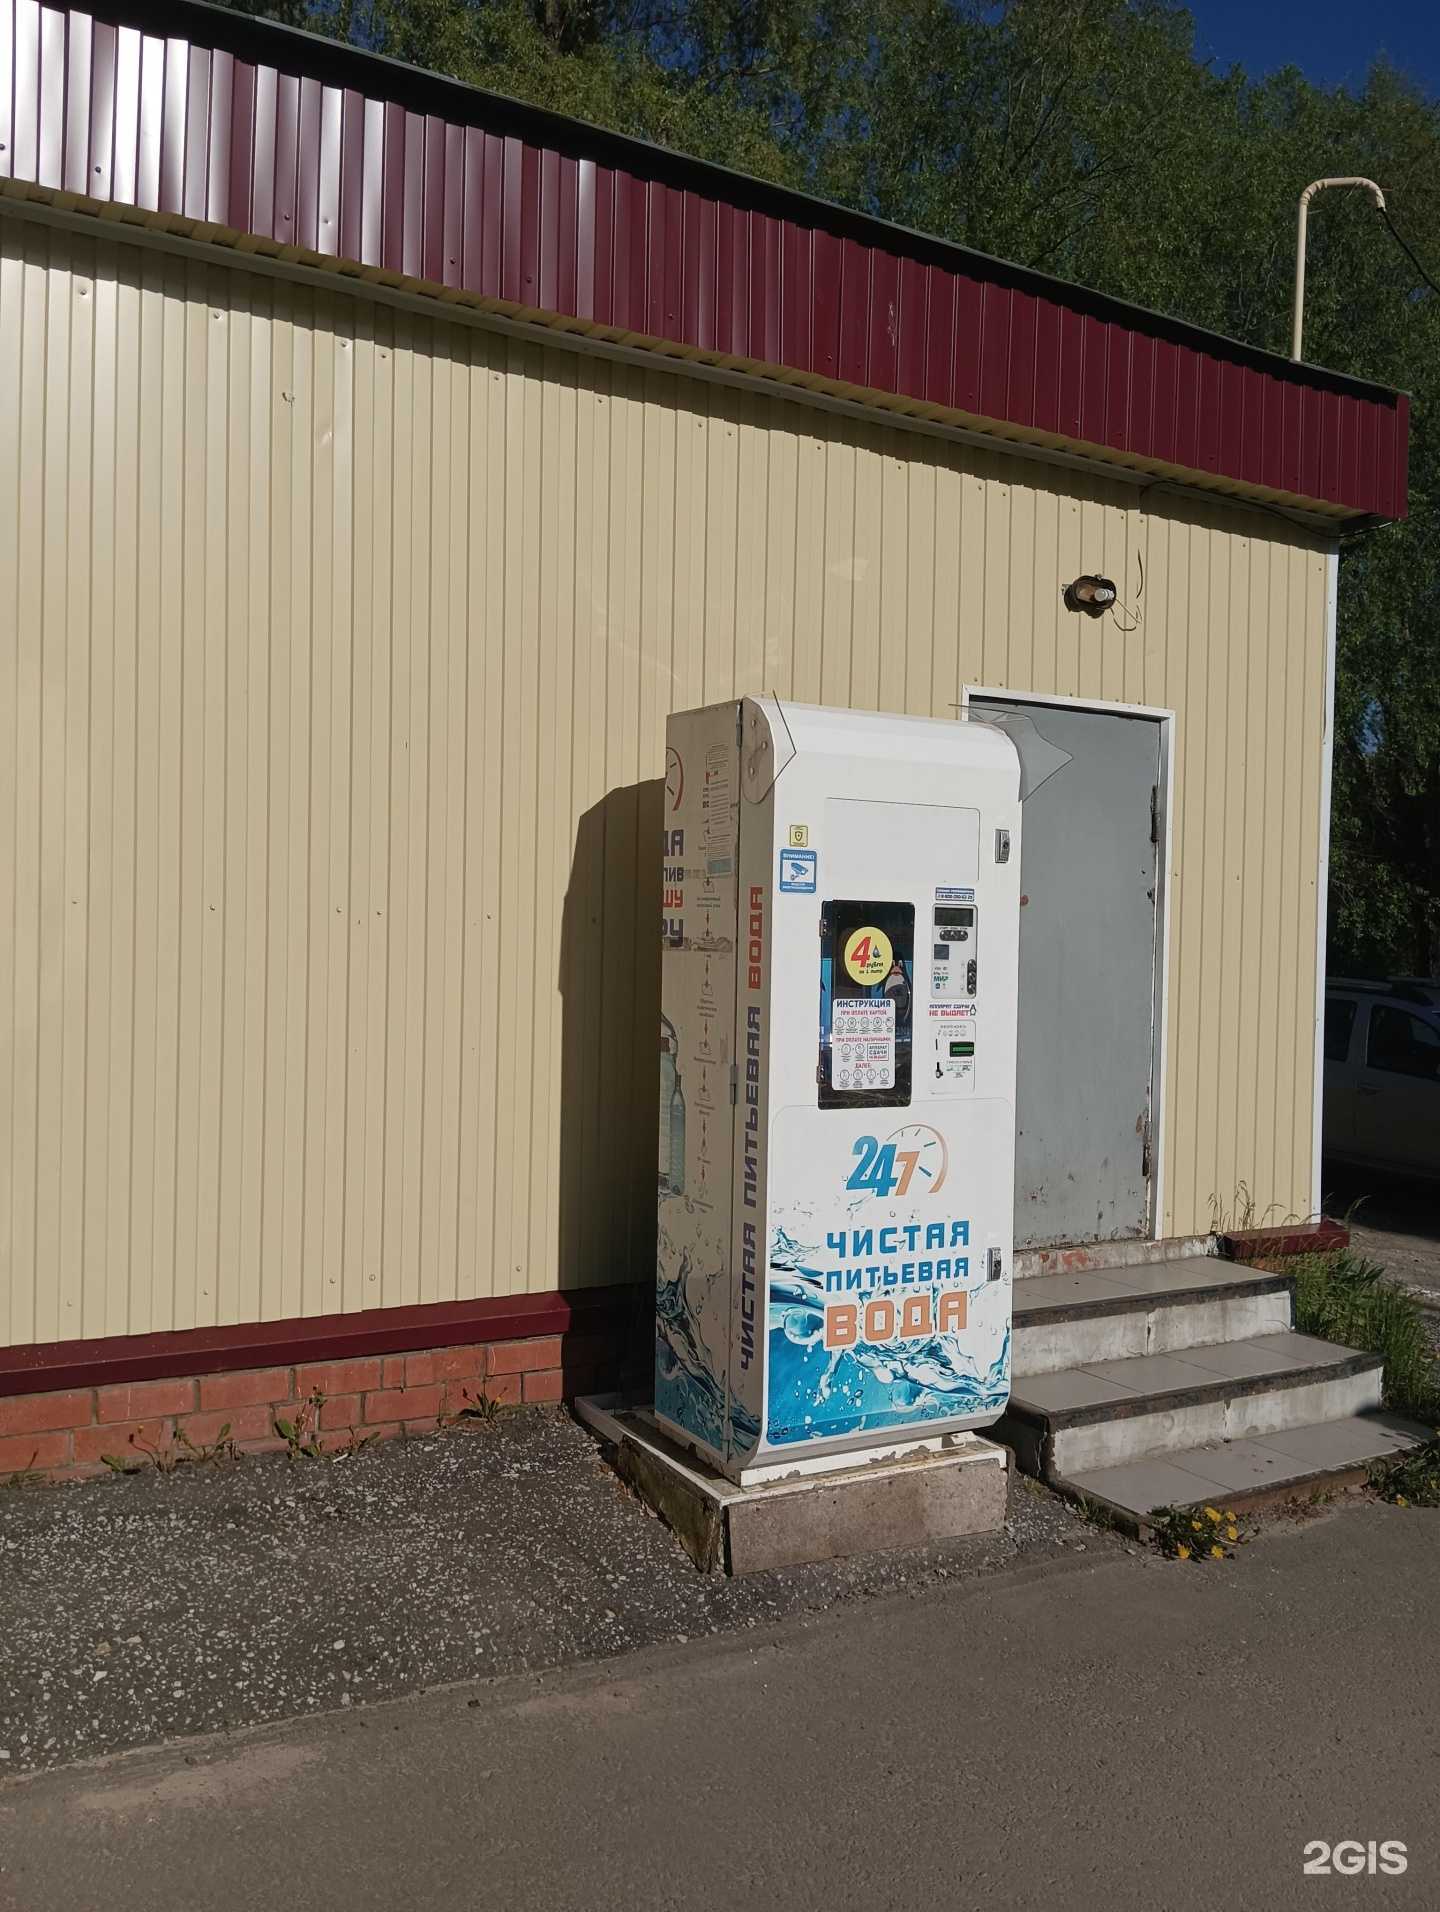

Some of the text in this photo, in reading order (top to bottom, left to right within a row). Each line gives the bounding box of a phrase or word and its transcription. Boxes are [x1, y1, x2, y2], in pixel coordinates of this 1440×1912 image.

[850, 936, 871, 968] 4
[837, 1000, 891, 1008] ИНСТРУКЦИЯ
[741, 886, 763, 1370] ЧИСТАЯ ПИТЬЕВАЯ ВОДА
[826, 1220, 970, 1258] ЧИСТАЯ
[825, 1256, 969, 1293] ПИТЬЕВАЯ
[826, 1290, 968, 1348] ВОДА
